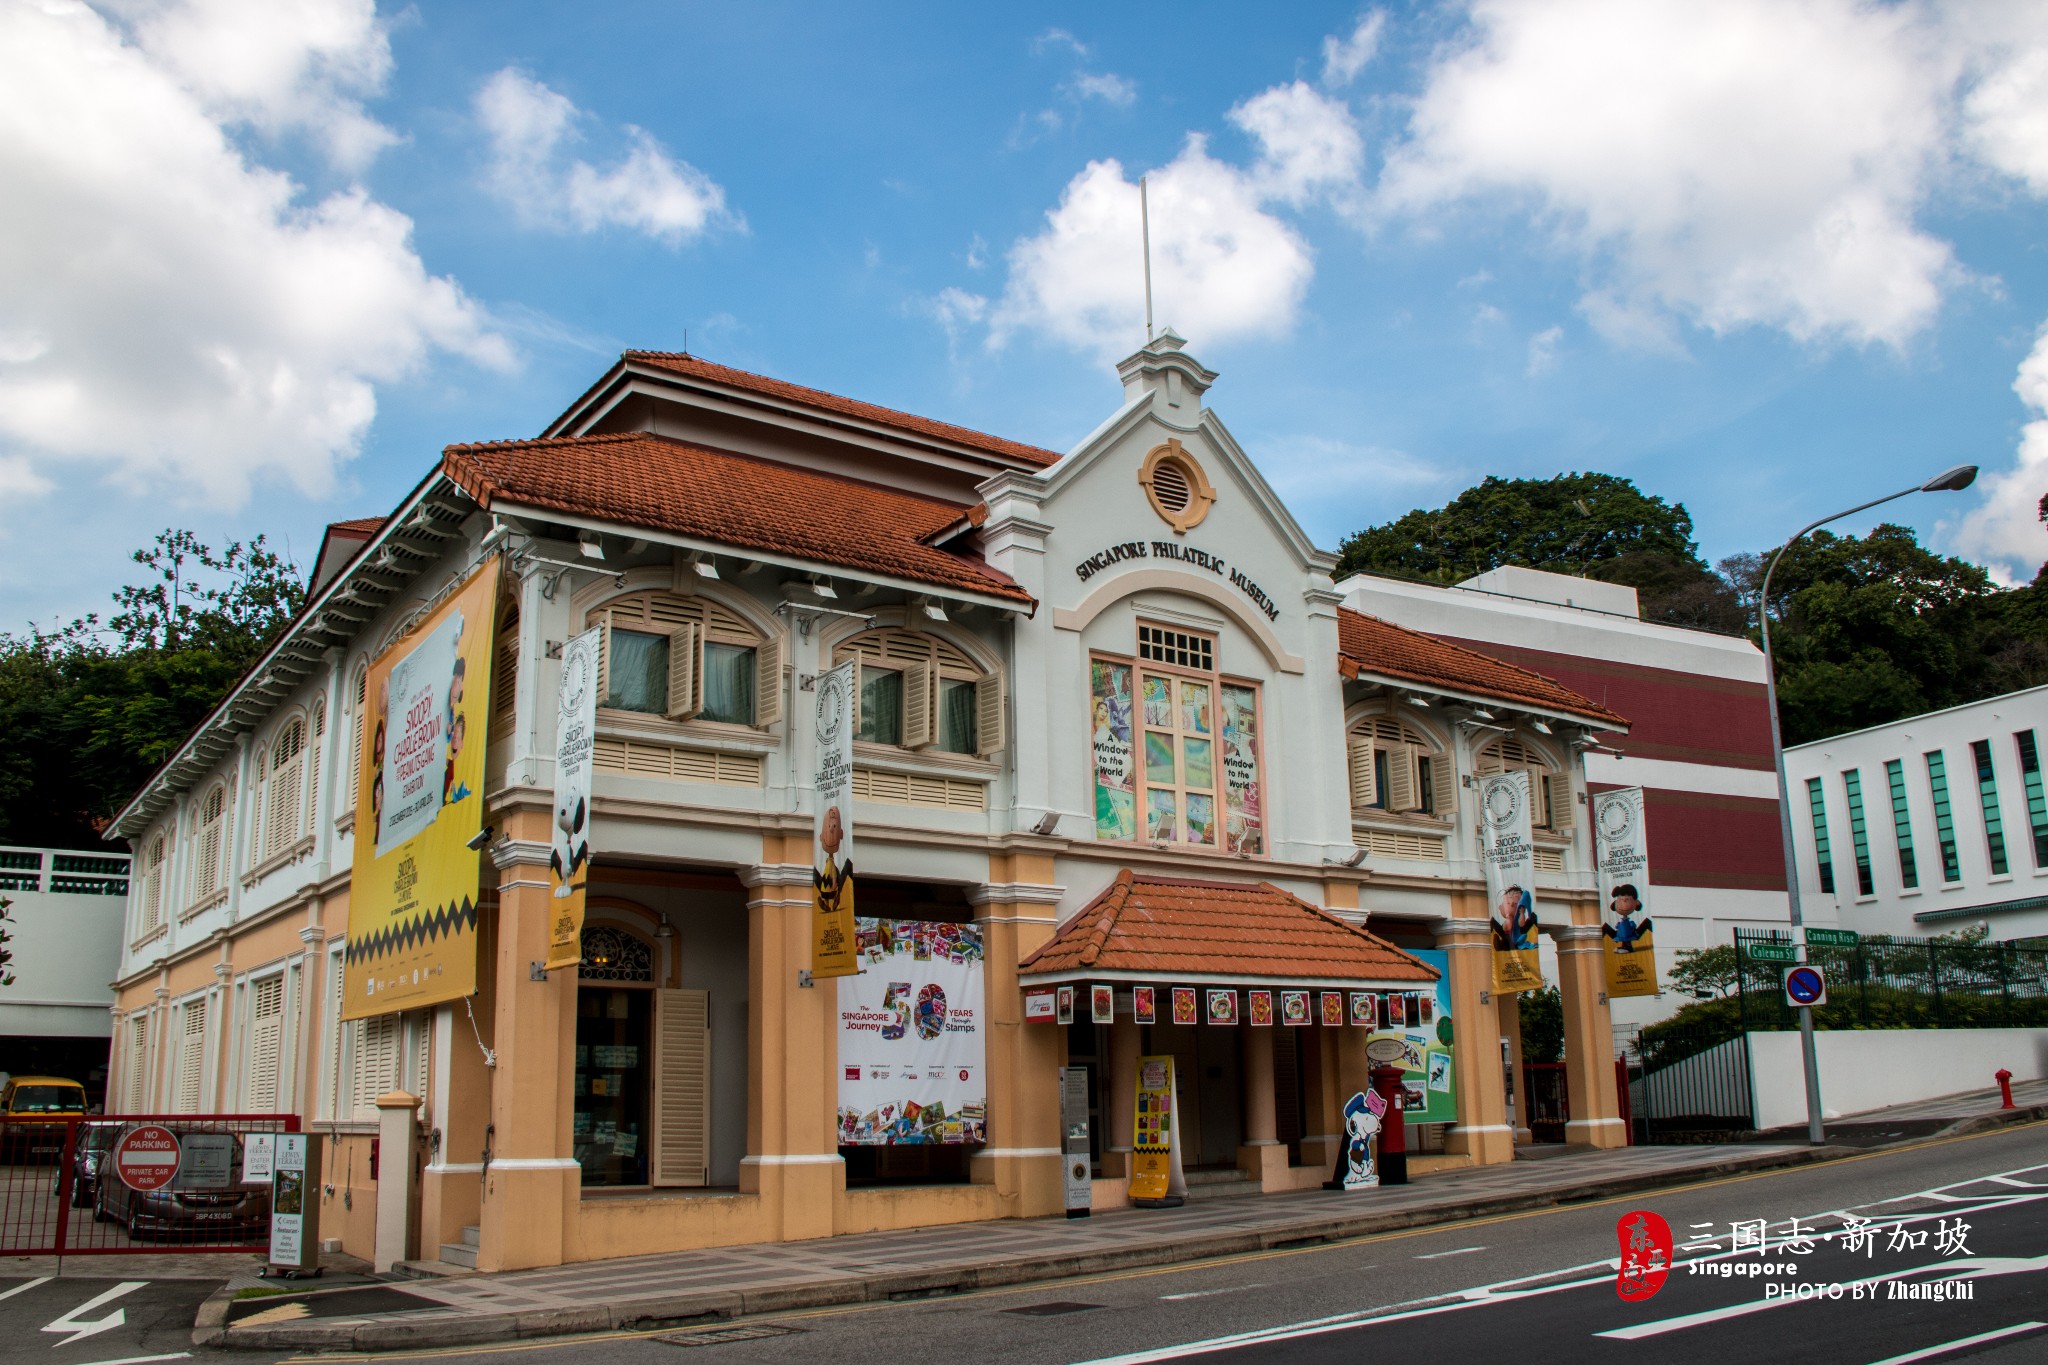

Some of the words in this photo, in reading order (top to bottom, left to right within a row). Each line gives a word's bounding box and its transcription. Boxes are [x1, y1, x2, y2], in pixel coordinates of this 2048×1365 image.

[1076, 542, 1147, 582] SINGAPORE
[1152, 542, 1225, 575] PHILATELIC
[1230, 568, 1280, 622] MUSEUM
[394, 730, 418, 764] CHARLIE
[418, 713, 442, 749] BROWN
[1108, 734, 1113, 742] A
[1094, 742, 1128, 754] Window
[1236, 749, 1240, 757] A
[1110, 756, 1123, 765] the
[1224, 757, 1254, 769] Window
[1100, 766, 1122, 776] World
[1238, 771, 1249, 779] the
[403, 774, 424, 799] EXHIBITION
[1230, 779, 1249, 789] World
[1510, 844, 1532, 854] BROWN
[1623, 855, 1646, 865] BROWN
[1807, 930, 1837, 944] Canning
[1840, 935, 1854, 943] Rise
[1753, 947, 1783, 958] Coleman
[1786, 949, 1794, 959] St
[882, 982, 947, 1040] 50
[842, 1013, 888, 1021] SINGAPORE
[846, 1022, 880, 1032] Journey
[946, 1024, 975, 1033] Stamps
[144, 1131, 158, 1139] NO
